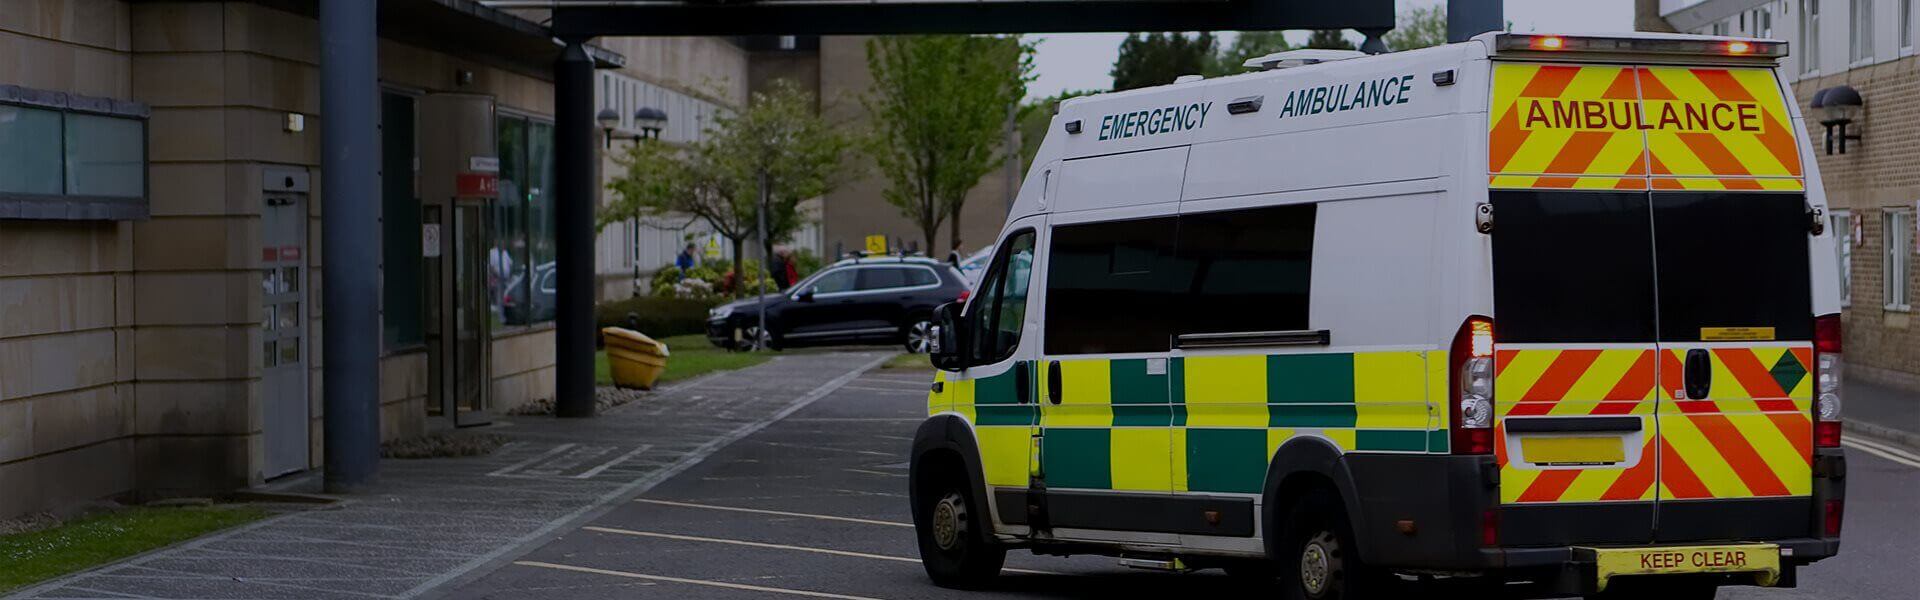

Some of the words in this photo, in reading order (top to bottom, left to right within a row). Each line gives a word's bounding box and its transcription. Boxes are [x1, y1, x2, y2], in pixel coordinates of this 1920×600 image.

[1098, 102, 1213, 141] EMERGENCY
[1280, 75, 1415, 119] AMBULANCE
[1525, 100, 1760, 131] AMBULANCE
[1640, 553, 1685, 568] KEEP
[1691, 552, 1746, 567] CLEAR
